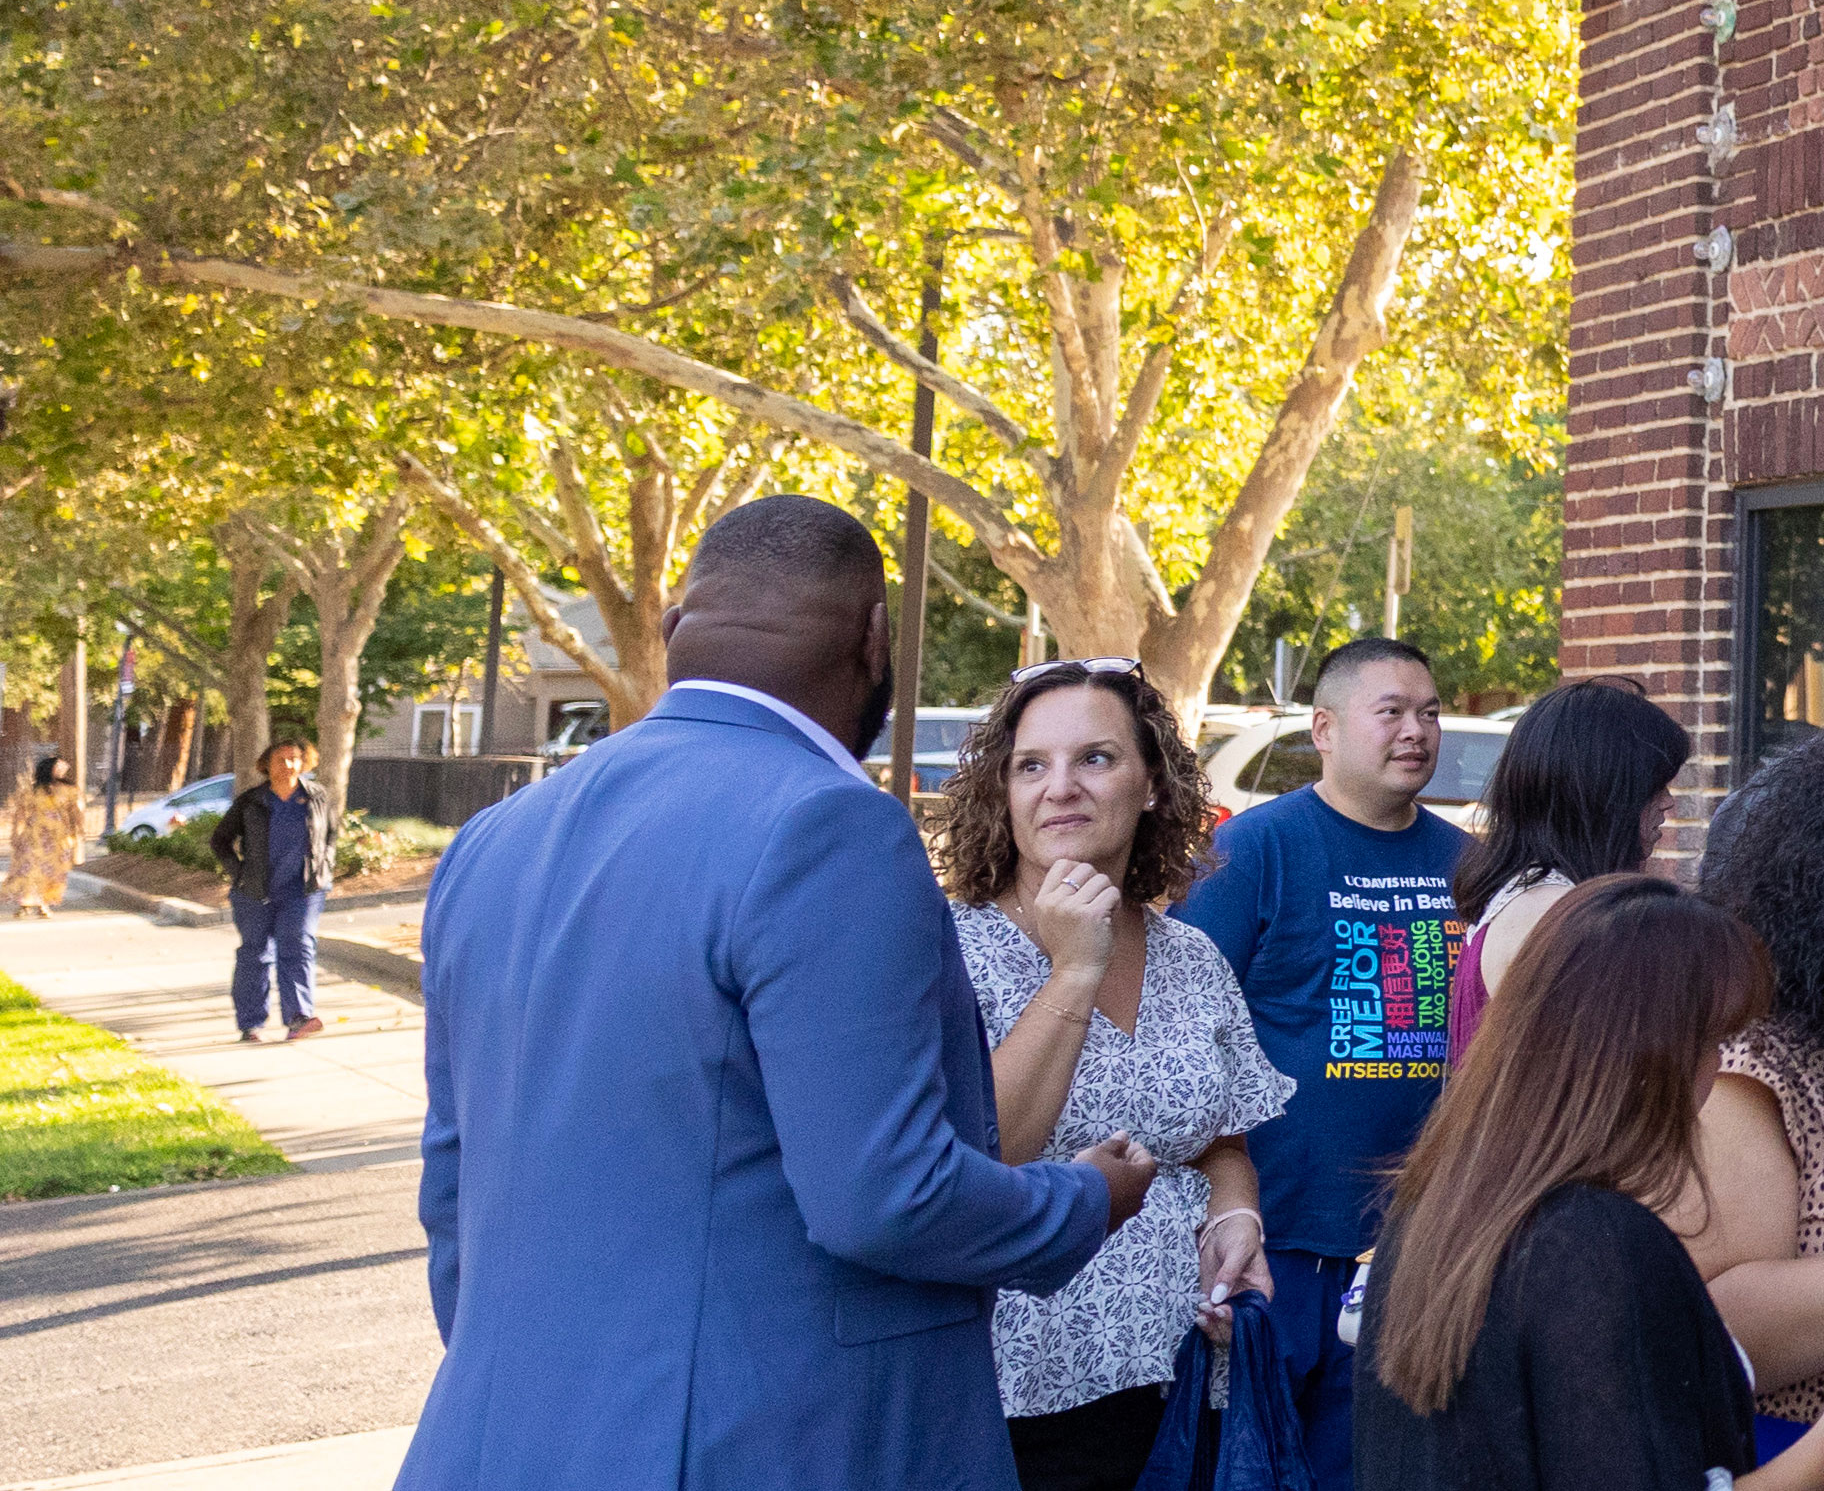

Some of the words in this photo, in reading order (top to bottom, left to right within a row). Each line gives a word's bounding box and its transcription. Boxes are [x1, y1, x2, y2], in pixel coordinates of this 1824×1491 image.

[1400, 876, 1447, 888] HEALTH
[1329, 891, 1390, 912] Believe
[1393, 895, 1413, 912] in
[1334, 919, 1353, 950] LO
[1331, 958, 1350, 991] EN
[1350, 921, 1384, 1059] MEJOR
[1378, 923, 1415, 1029] 相信更好
[1330, 997, 1351, 1058] CREE
[1418, 996, 1433, 1028] TIN
[1387, 1031, 1448, 1044] MANIWAL
[1387, 1045, 1423, 1059] MAS
[1326, 1062, 1403, 1079] NTSEEG
[1407, 1062, 1441, 1079] ZOO
